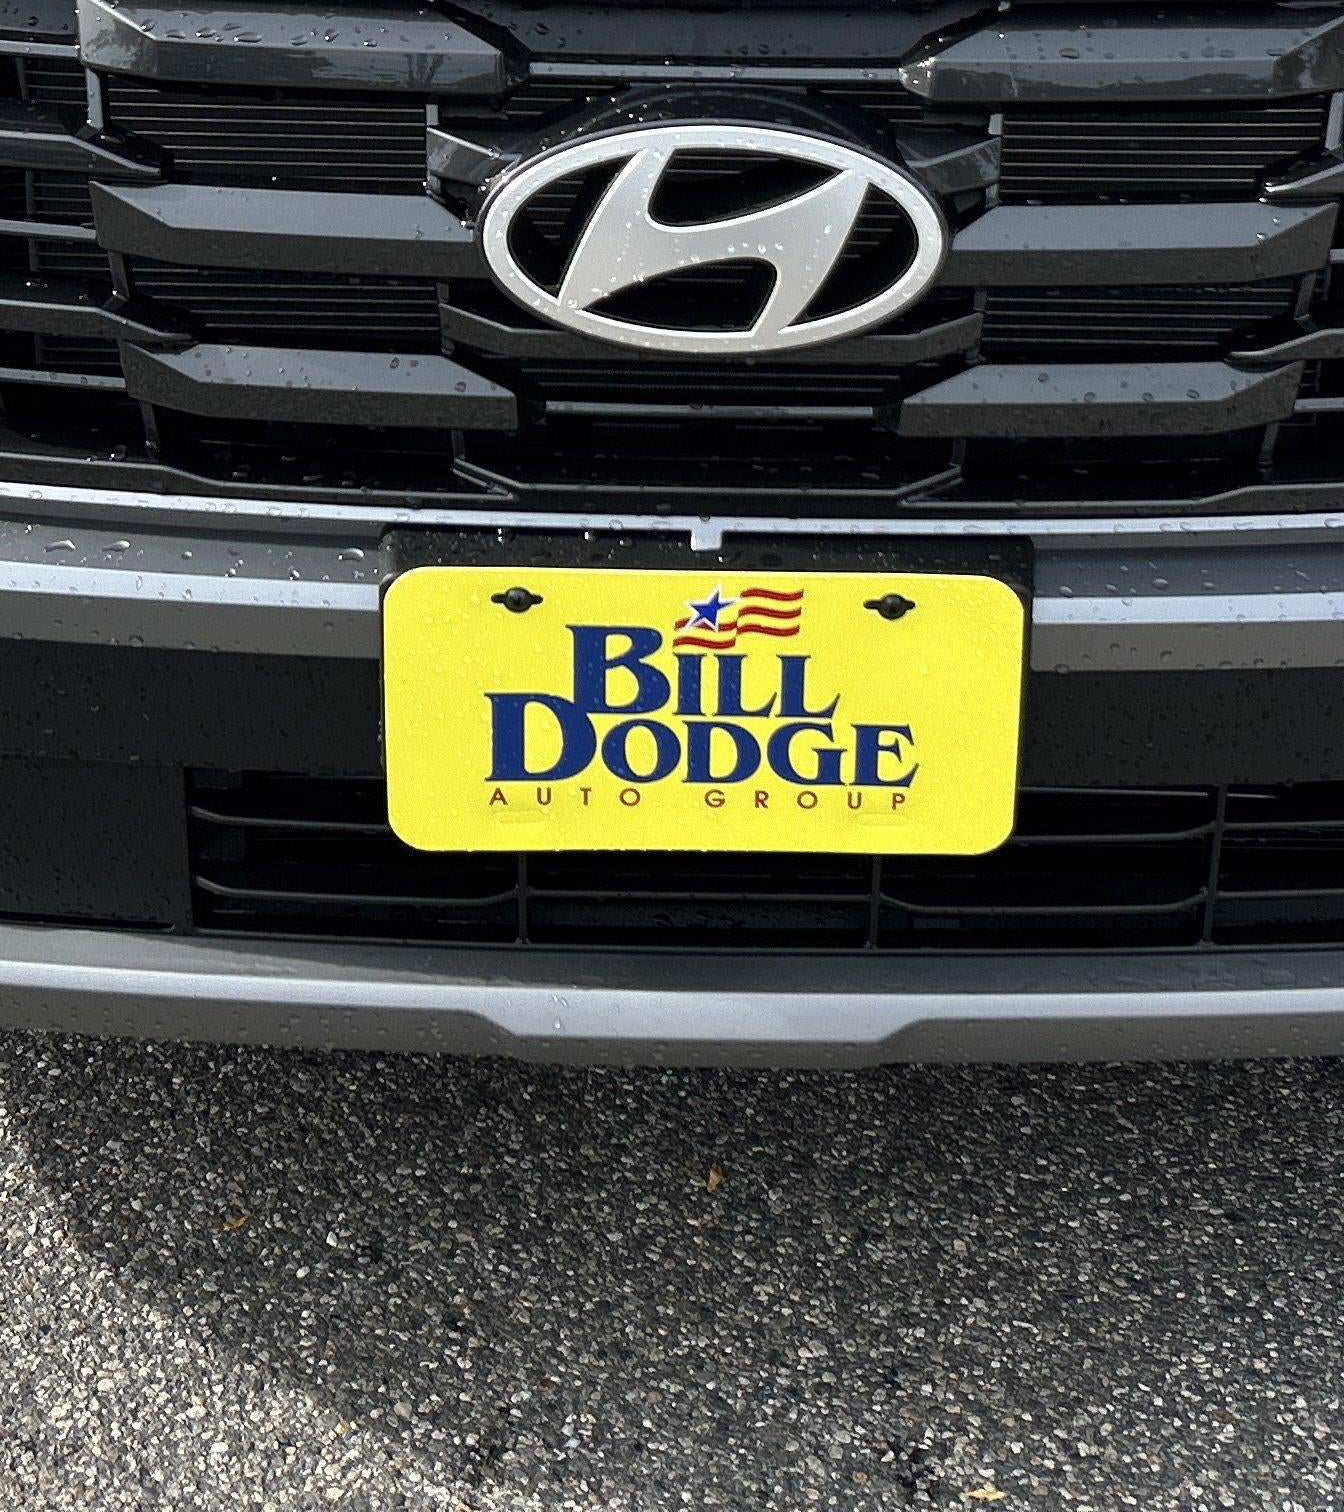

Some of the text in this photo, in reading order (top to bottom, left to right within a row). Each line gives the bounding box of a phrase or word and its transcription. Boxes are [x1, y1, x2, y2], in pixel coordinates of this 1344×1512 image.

[566, 624, 840, 719] BILL
[484, 692, 920, 788] DODGE
[488, 787, 907, 811] AUTO GROUP
